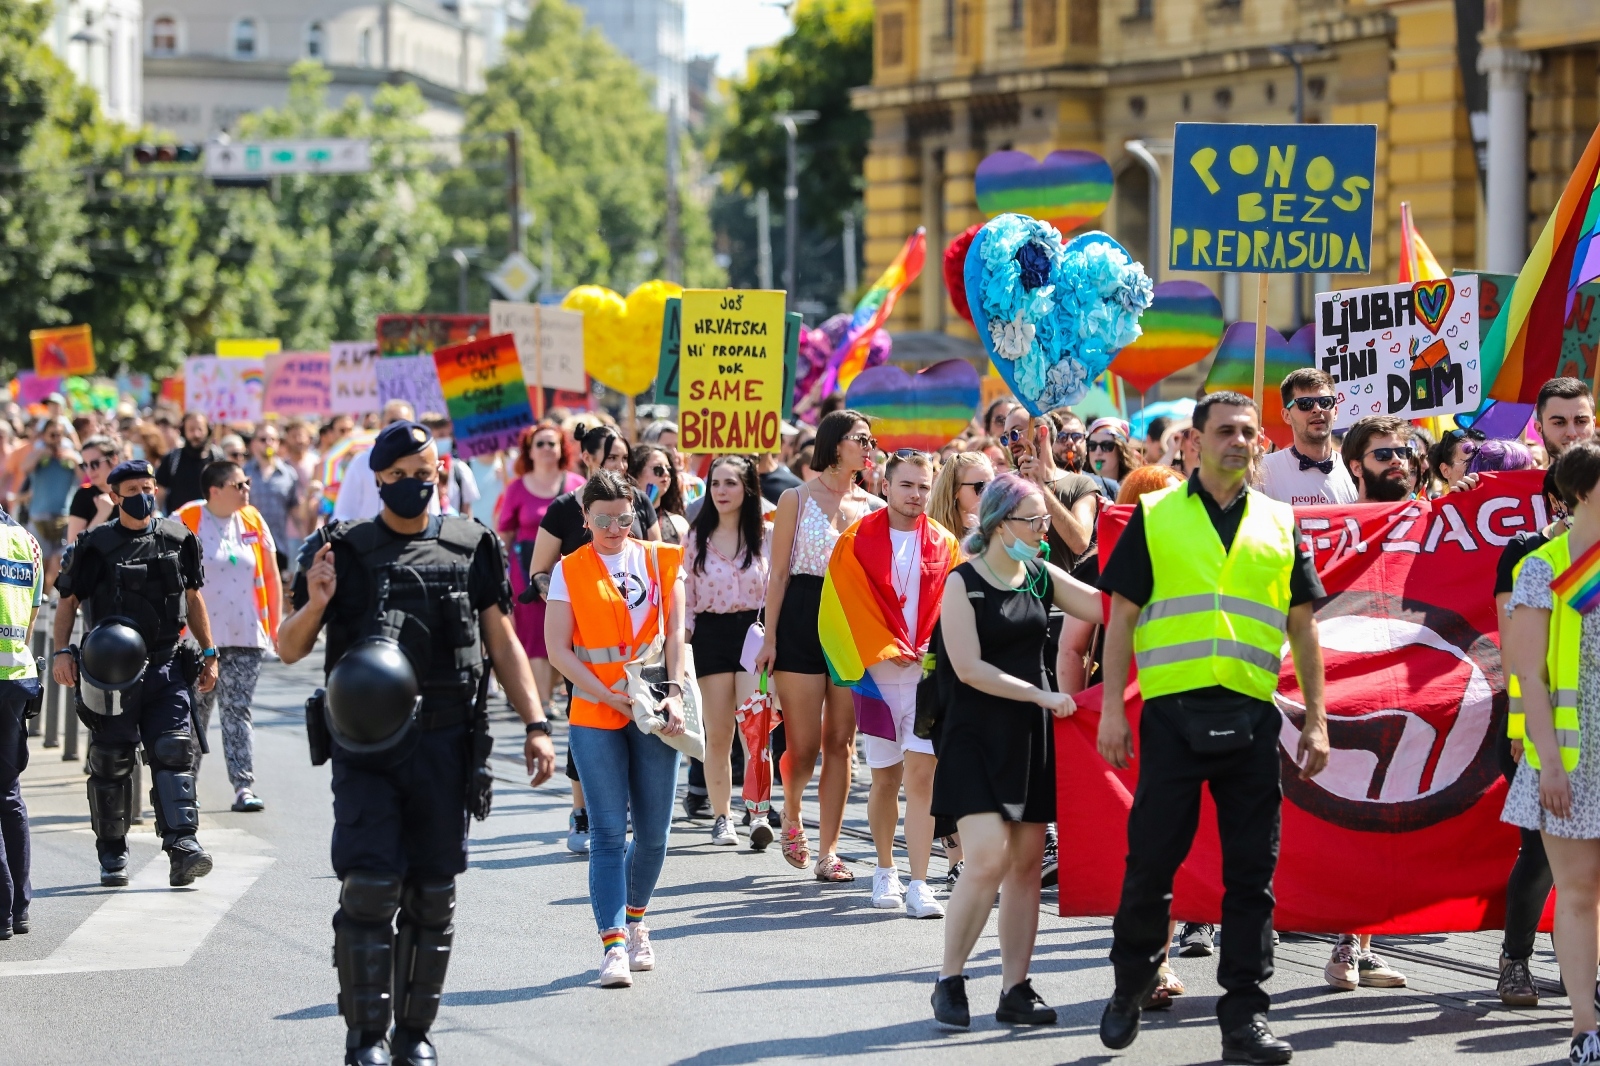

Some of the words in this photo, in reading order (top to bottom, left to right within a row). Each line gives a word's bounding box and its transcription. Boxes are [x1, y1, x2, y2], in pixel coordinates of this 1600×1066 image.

[1190, 144, 1371, 212] PONOS
[1237, 192, 1329, 223] BEZ
[1171, 228, 1366, 270] PREDRASUDA
[720, 294, 744, 311] JOŠ
[694, 318, 768, 336] HRVATSKA
[712, 345, 767, 359] PROPALA
[718, 362, 744, 375] DOK
[689, 379, 764, 402] SAME
[1387, 362, 1464, 415] DOM
[1291, 494, 1326, 506] people
[0, 564, 32, 581] OLICIJA
